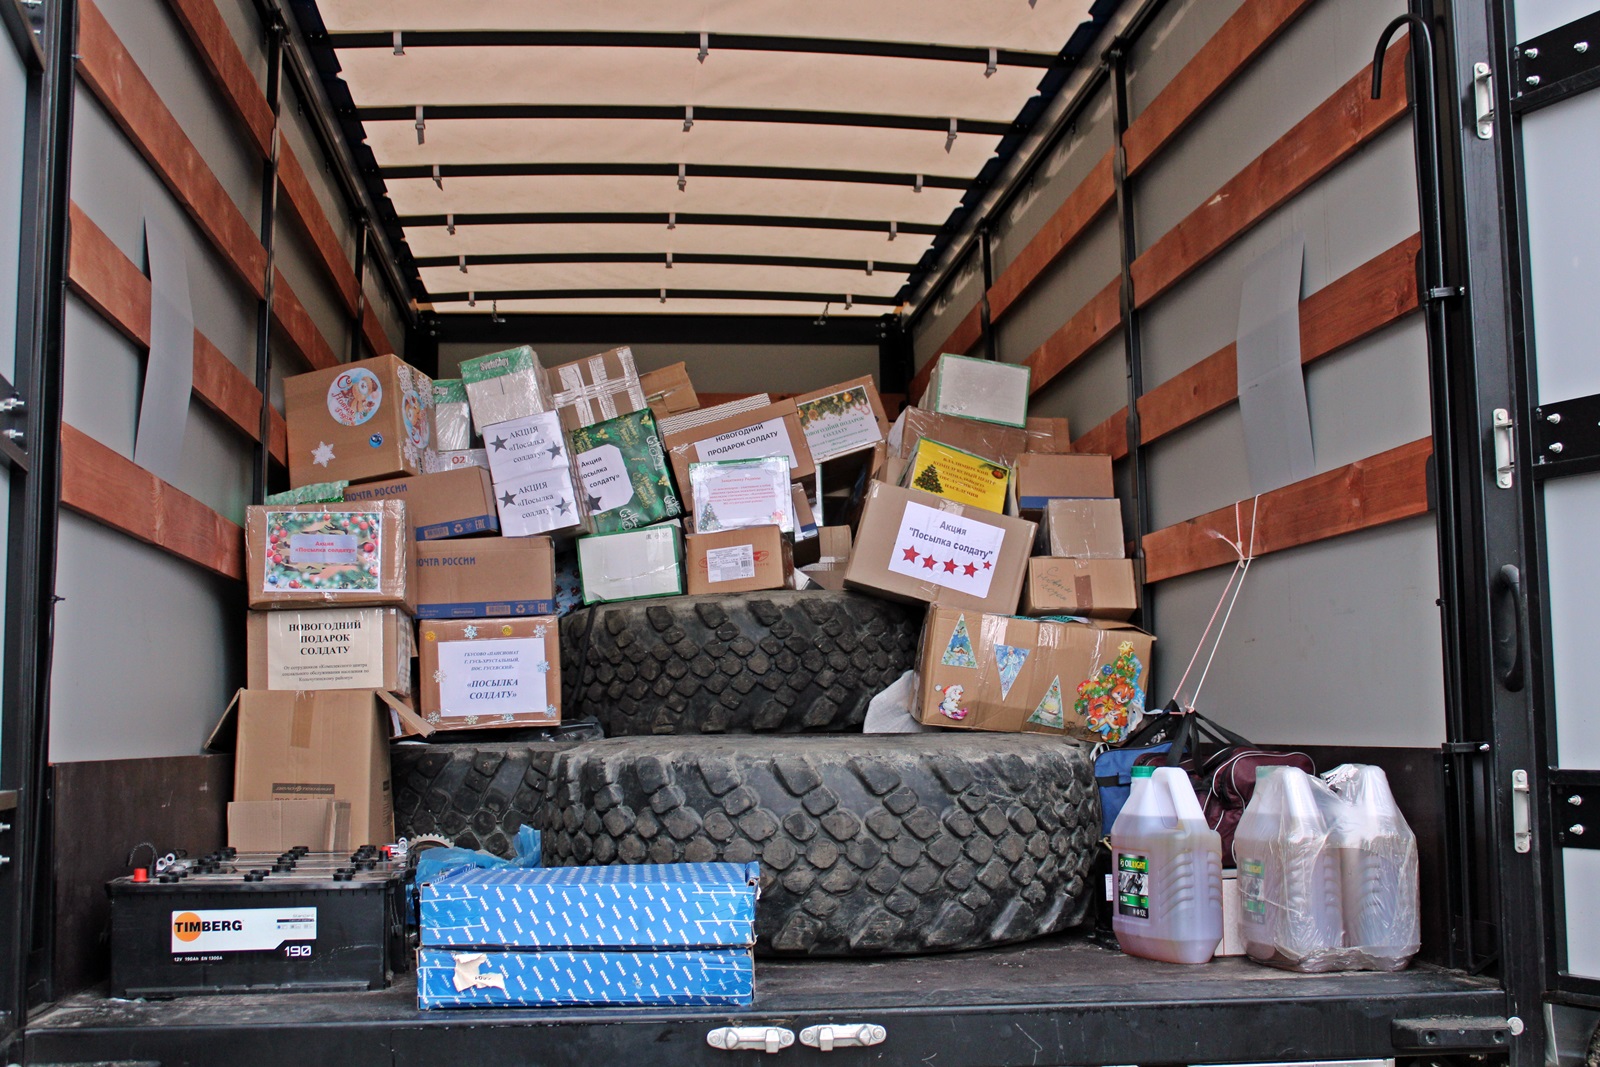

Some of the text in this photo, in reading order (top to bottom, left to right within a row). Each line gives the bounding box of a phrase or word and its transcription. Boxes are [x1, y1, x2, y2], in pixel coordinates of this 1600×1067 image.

[509, 425, 539, 440] АКЦИЯ
[509, 438, 545, 451] «Посылка
[707, 430, 778, 456] ПРОДАРОК СОЛДАТУ
[513, 451, 546, 463] солдату»
[581, 456, 602, 467] Акция
[518, 481, 548, 494] АКЦИЯ
[589, 474, 620, 488] солдату»
[375, 483, 408, 497] РОССИИ
[517, 494, 554, 507] «Посылка
[939, 520, 967, 536] Акция
[909, 527, 993, 560] "Посылка солдату"
[442, 557, 476, 566] РОССИИ
[289, 620, 361, 632] НОВОГОДНИЙ
[300, 633, 350, 643] ПОДАРОК
[300, 646, 350, 656] СОЛДАТУ
[467, 679, 518, 688] «ПОСЫЛКА
[469, 690, 517, 700] СОЛДАТУ»
[174, 920, 243, 933] TIMBERG
[284, 945, 312, 957] 190
